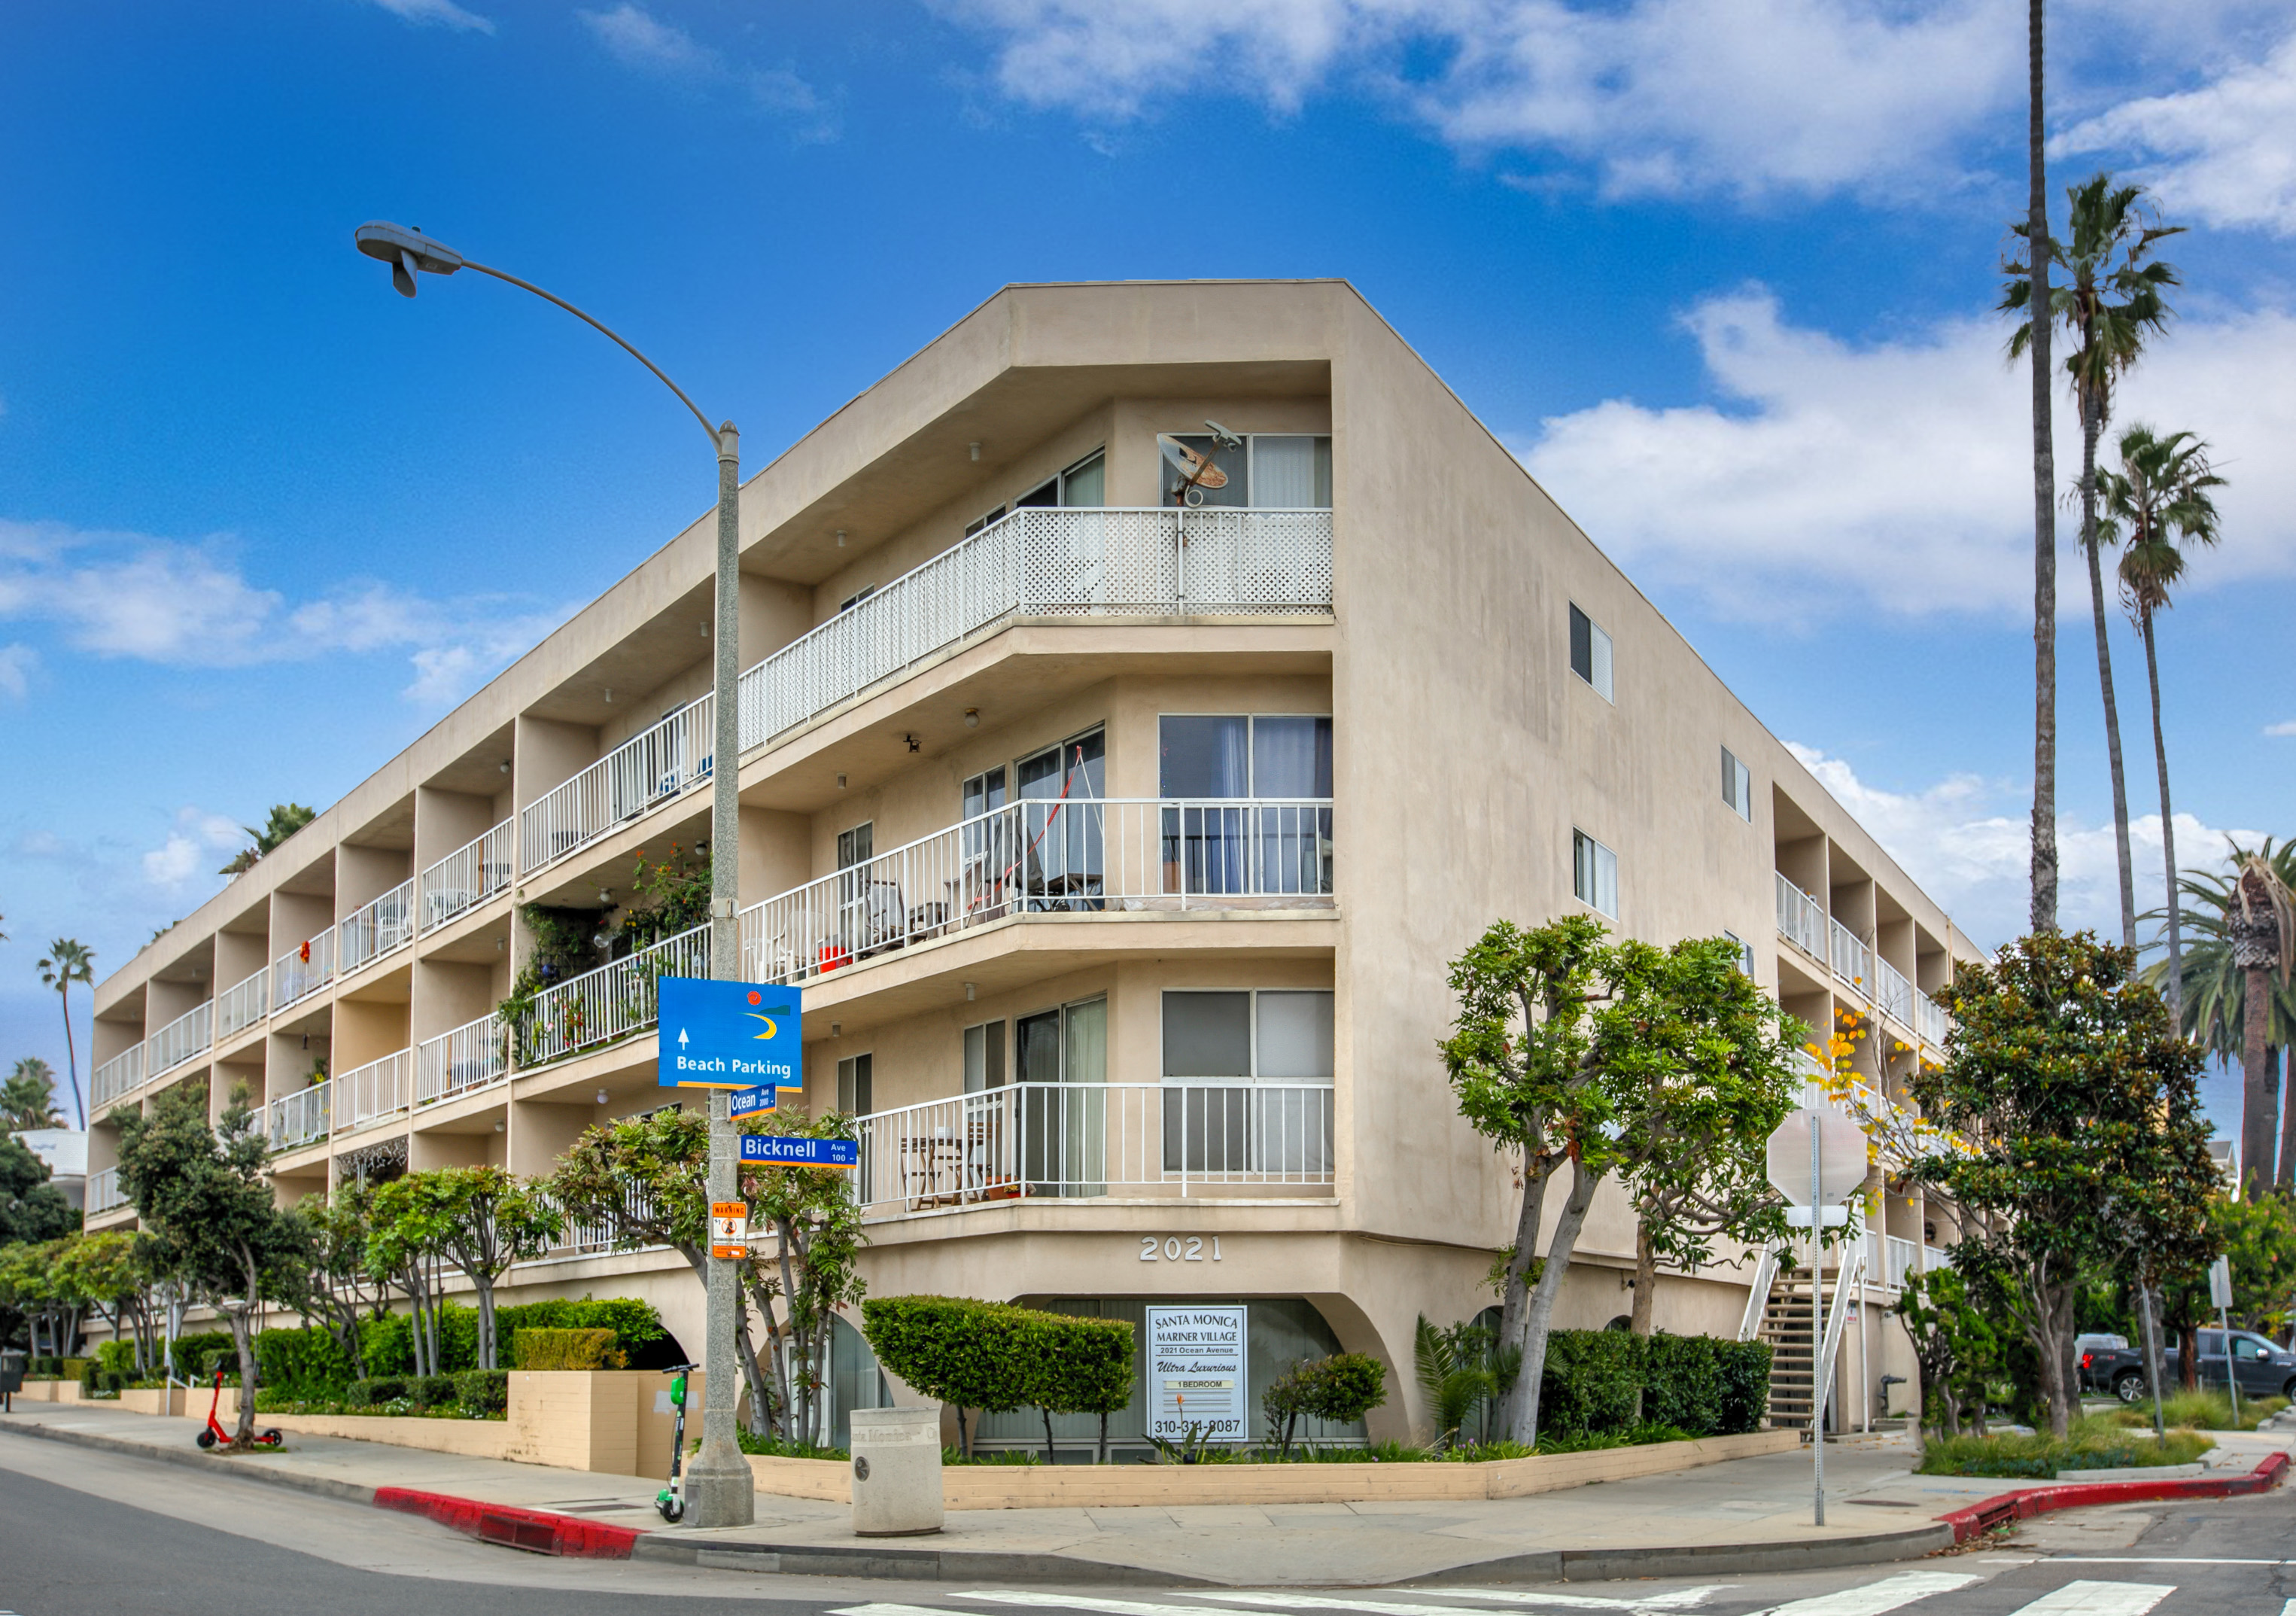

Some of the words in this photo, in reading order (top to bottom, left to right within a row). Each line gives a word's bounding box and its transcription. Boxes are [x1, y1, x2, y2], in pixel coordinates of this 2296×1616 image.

[677, 1055, 725, 1072] Beach
[732, 1059, 791, 1079] Parking
[761, 1088, 769, 1097] Ave
[731, 1094, 756, 1111] Ocean
[759, 1097, 769, 1107] 2000
[745, 1138, 816, 1158] Bicknell
[830, 1143, 846, 1152] Ave
[832, 1154, 846, 1162] 100
[1139, 1236, 1222, 1261] 2021
[1155, 1315, 1191, 1330] SANTA
[1193, 1314, 1238, 1330] MONICA
[1157, 1331, 1198, 1342] MARINER
[1200, 1331, 1237, 1341] VILLAGE
[1157, 1361, 1187, 1373] Ultra
[1188, 1361, 1238, 1374] Luxurious
